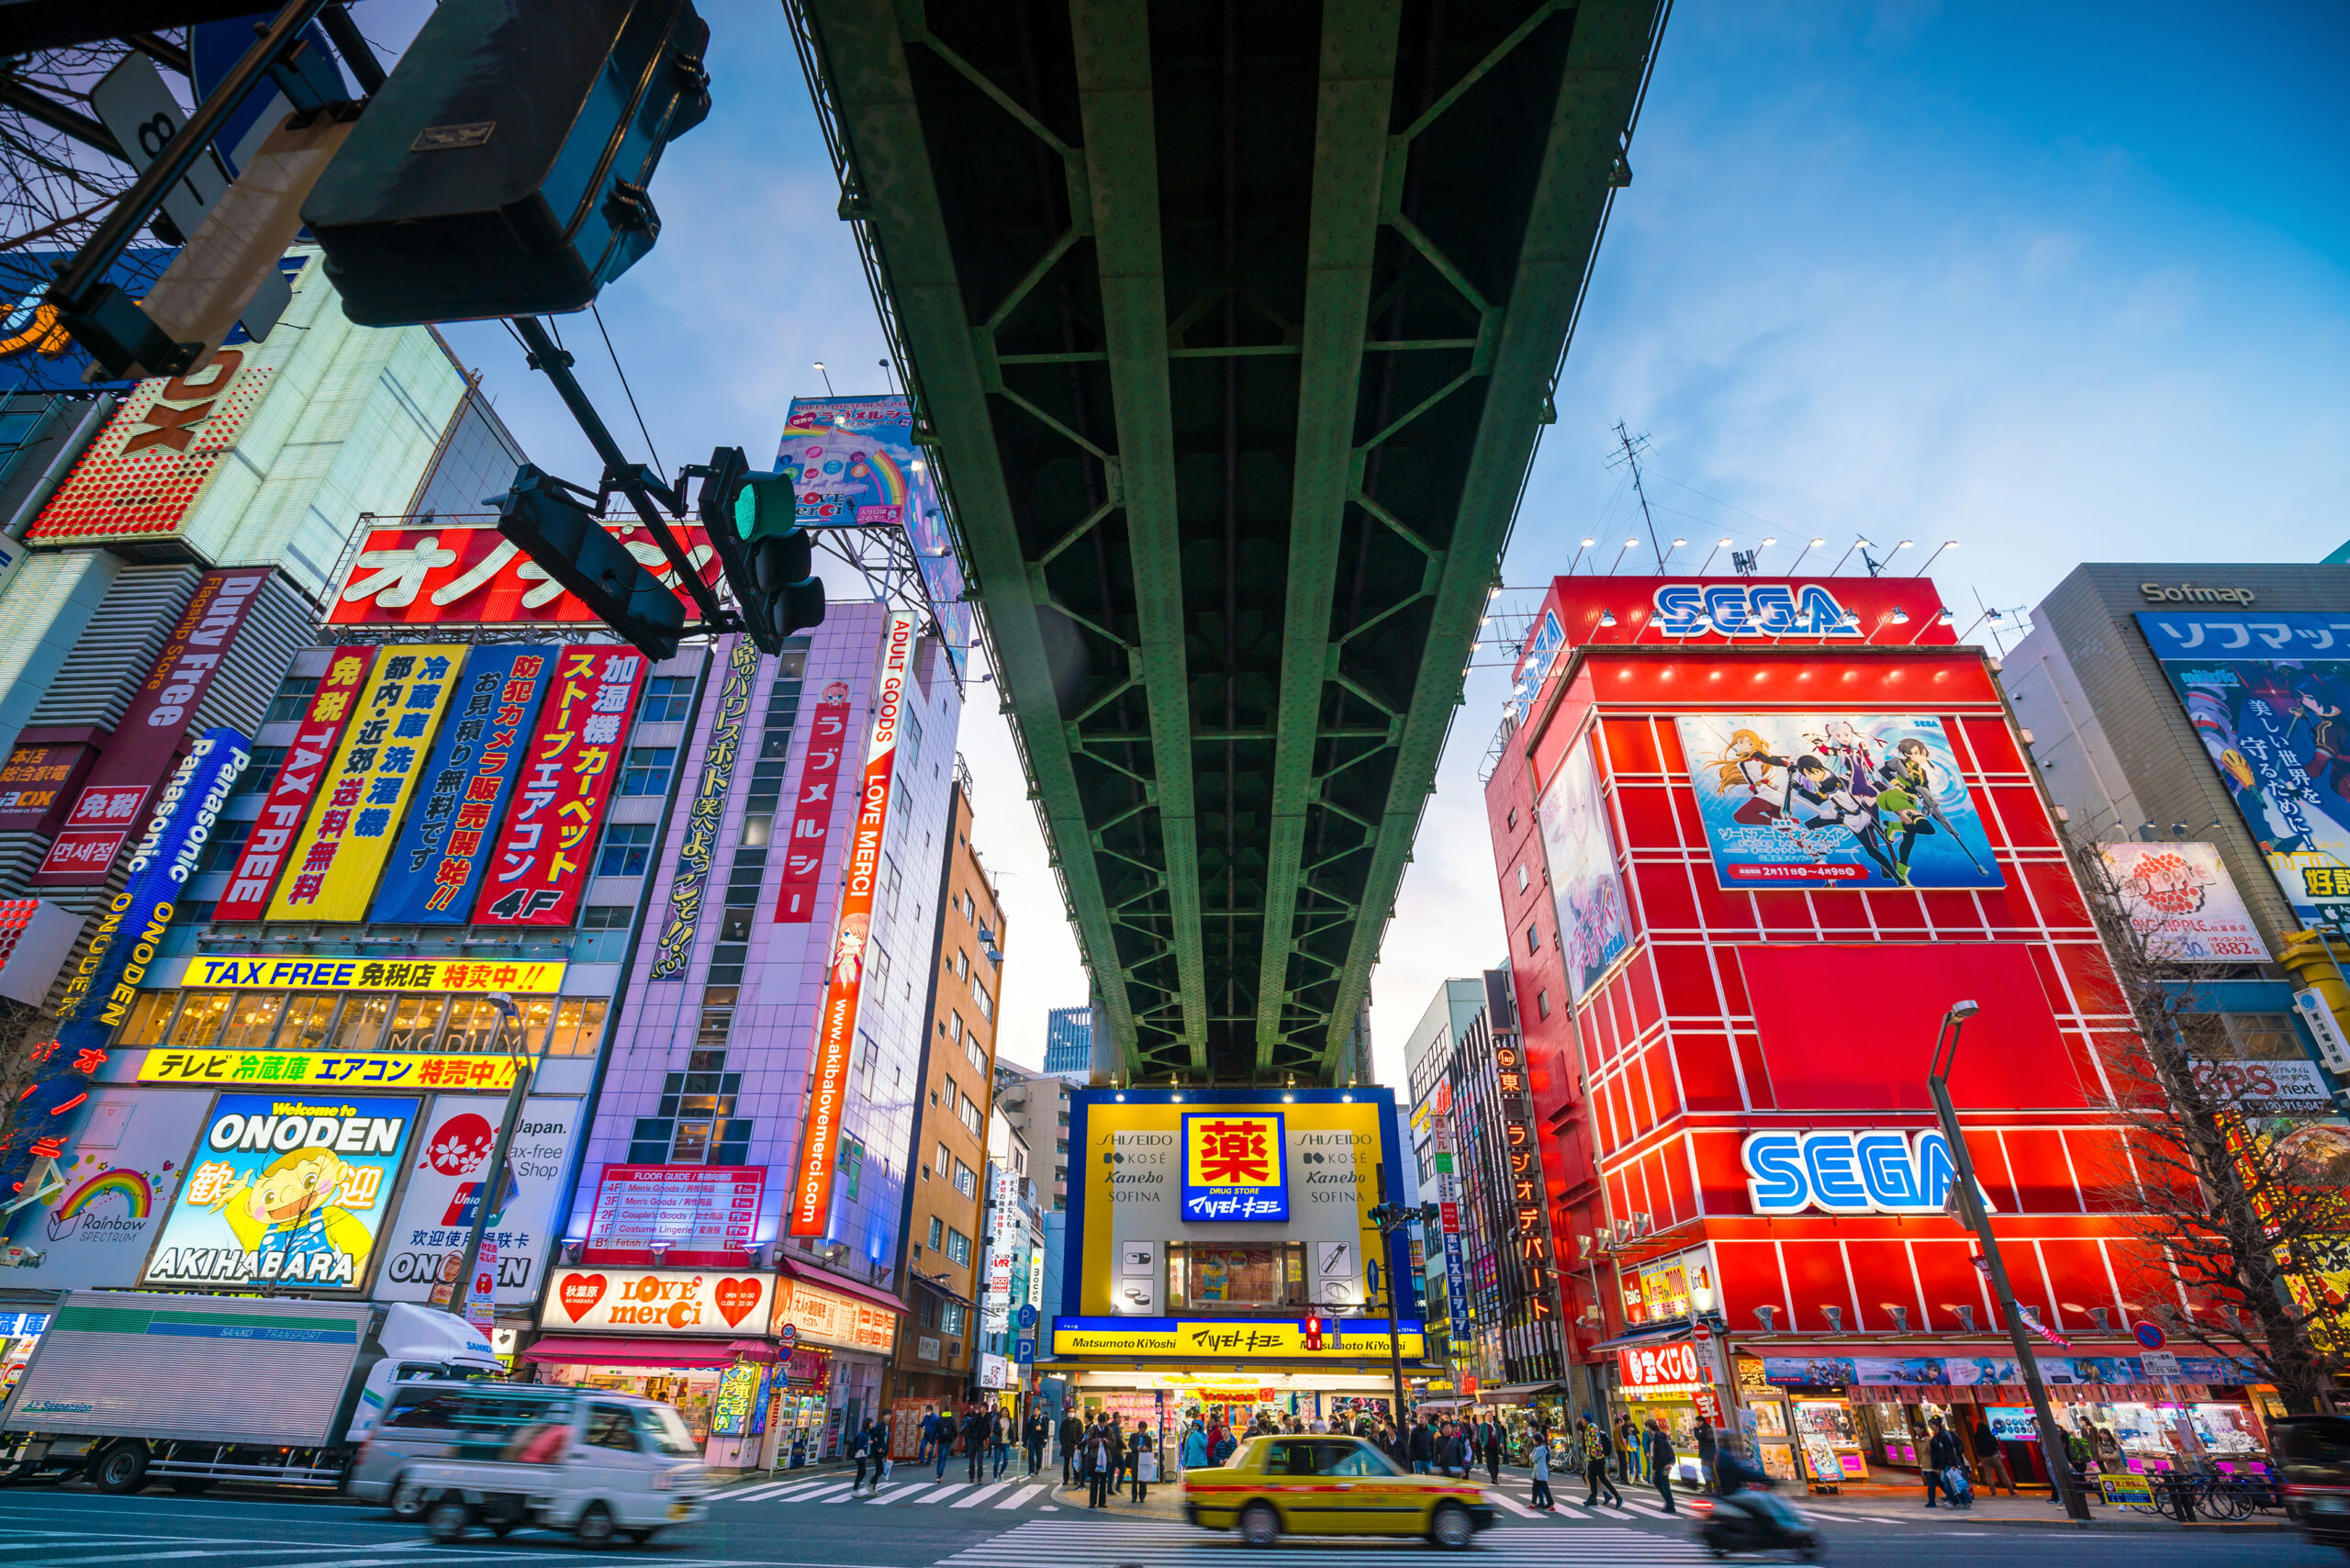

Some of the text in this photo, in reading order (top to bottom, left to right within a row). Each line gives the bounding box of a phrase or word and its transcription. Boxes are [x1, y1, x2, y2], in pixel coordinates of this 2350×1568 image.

[2141, 582, 2255, 607] Sofmap
[1653, 584, 1864, 639] SEGA
[148, 577, 223, 690] Flagship Store
[148, 575, 263, 727] Duty Free
[1516, 609, 1568, 725] SEGA
[875, 619, 910, 743] ADULT GOODS
[2248, 700, 2322, 804] 美しい世界を
[226, 655, 364, 904] 免税 TAX FREE
[409, 671, 503, 873] お見積り無料です
[2240, 736, 2315, 851] 守るために!
[76, 793, 140, 818] 免税
[128, 738, 218, 873] Panasonic
[169, 745, 251, 883] Panasonic
[789, 714, 843, 914] ラブメルシー
[850, 774, 887, 897] LOVE MERCI
[1718, 828, 1853, 840] ソードアート・オンライン
[52, 842, 116, 862] 면세점
[488, 890, 564, 919] 4F
[1604, 930, 1626, 965] SEGA
[101, 902, 173, 1026] ONODEN
[204, 962, 268, 986] TAX
[269, 962, 355, 986] FREE
[359, 963, 436, 988] 免税店
[158, 1054, 232, 1077] テレビ
[232, 1056, 310, 1081] 冷蔵庫
[315, 1058, 412, 1081] エアコン
[2281, 1083, 2319, 1094] next
[272, 1102, 357, 1117] Welcome to
[801, 998, 846, 1223] www.akibalovemerci.com
[209, 1114, 405, 1154] ONODEN
[516, 1119, 567, 1137] Japan.
[1096, 1133, 1173, 1147] SHISEIDO
[1293, 1133, 1372, 1147] SHISEIDO
[509, 1144, 563, 1159] ax-free
[1128, 1151, 1167, 1164] KOSÉ
[1200, 1121, 1270, 1183] 薬
[1328, 1151, 1367, 1164] KOSÉ
[519, 1161, 558, 1181] Shop
[634, 1172, 662, 1181] FLOOR
[665, 1172, 690, 1181] GUIDE
[1104, 1170, 1164, 1184] Kanebo
[1306, 1170, 1366, 1184] Kanebo
[1741, 1130, 1998, 1214] SEGA
[608, 1182, 621, 1192] 4F
[628, 1184, 651, 1193] Men's
[653, 1184, 679, 1193] Goods
[1109, 1192, 1160, 1203] SOFINA
[604, 1196, 618, 1206] 3F
[625, 1198, 648, 1206] Men's
[650, 1198, 677, 1206] Goods
[1312, 1192, 1365, 1204] SOFINA
[83, 1215, 147, 1231] Rainbow
[601, 1210, 615, 1219] 2F
[659, 1212, 687, 1220] Goods
[80, 1231, 139, 1242] SPECTRUM
[599, 1224, 611, 1233] 1F
[619, 1225, 656, 1234] Costume
[658, 1226, 693, 1235] Lingerie
[616, 1238, 641, 1248] Fetish
[150, 1247, 355, 1283] AKIHABARA
[565, 1285, 599, 1298] 秋葉原
[620, 1275, 699, 1303] LOVE
[1447, 1234, 1466, 1331] ホビーステーション
[1625, 1285, 1641, 1305] BIG
[220, 1327, 321, 1341] SANKO TRANSPORT
[784, 1327, 793, 1337] 20
[466, 1341, 492, 1354] SANKO
[1072, 1338, 1177, 1350] Matsumoto KiYoshi
[1641, 1347, 1682, 1384] 宝くじ
[42, 1401, 92, 1413] Suspension
